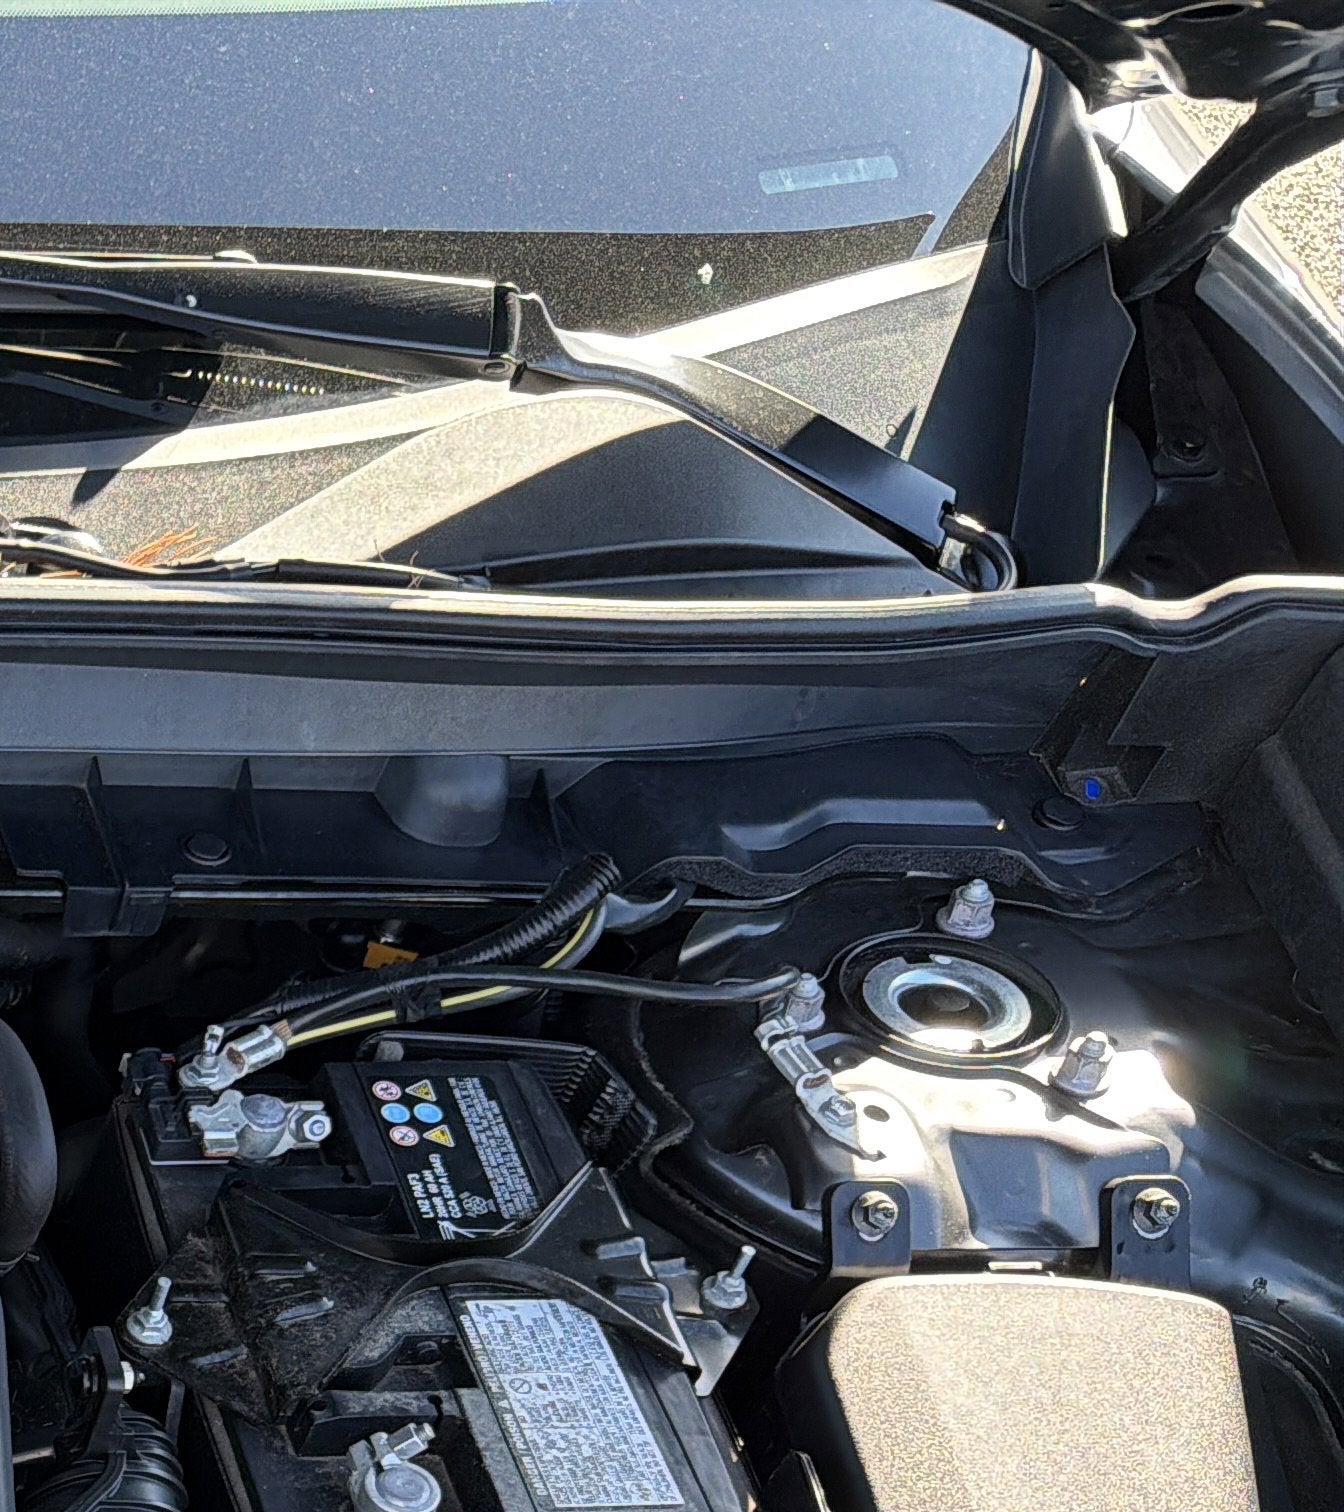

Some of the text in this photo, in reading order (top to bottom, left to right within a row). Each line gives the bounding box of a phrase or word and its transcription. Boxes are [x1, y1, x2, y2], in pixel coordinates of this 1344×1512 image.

[421, 1169, 437, 1185] AH
[407, 1173, 434, 1219] LN2 PAF3
[446, 1199, 464, 1219] CCA
